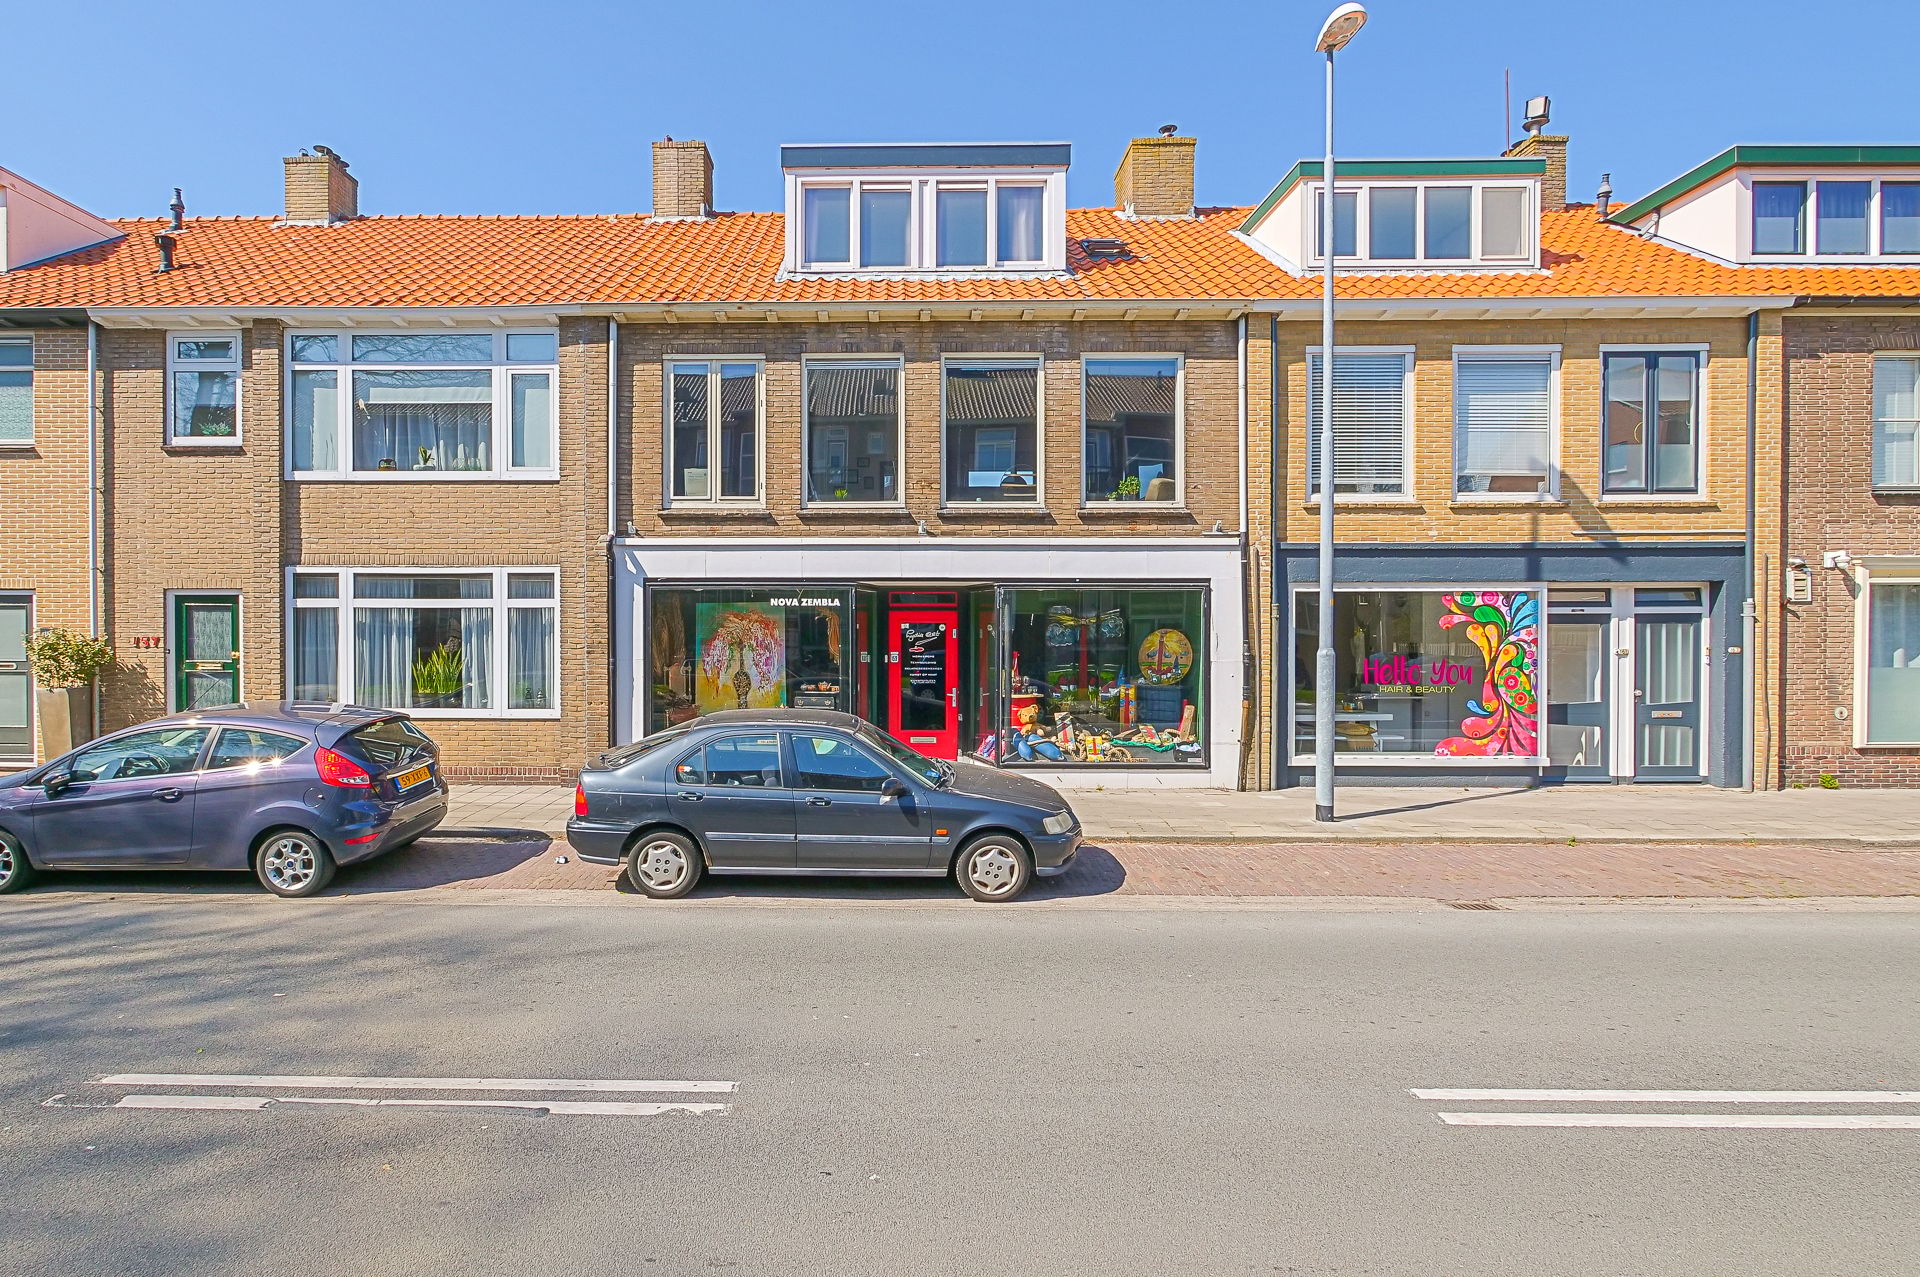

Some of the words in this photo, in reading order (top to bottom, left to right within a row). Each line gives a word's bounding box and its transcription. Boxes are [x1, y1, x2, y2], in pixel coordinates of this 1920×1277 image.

[770, 597, 799, 607] NOVA
[801, 598, 840, 607] ZEMBLA
[133, 636, 160, 649] 157
[1363, 655, 1422, 685] Hello
[1430, 658, 1473, 685] You
